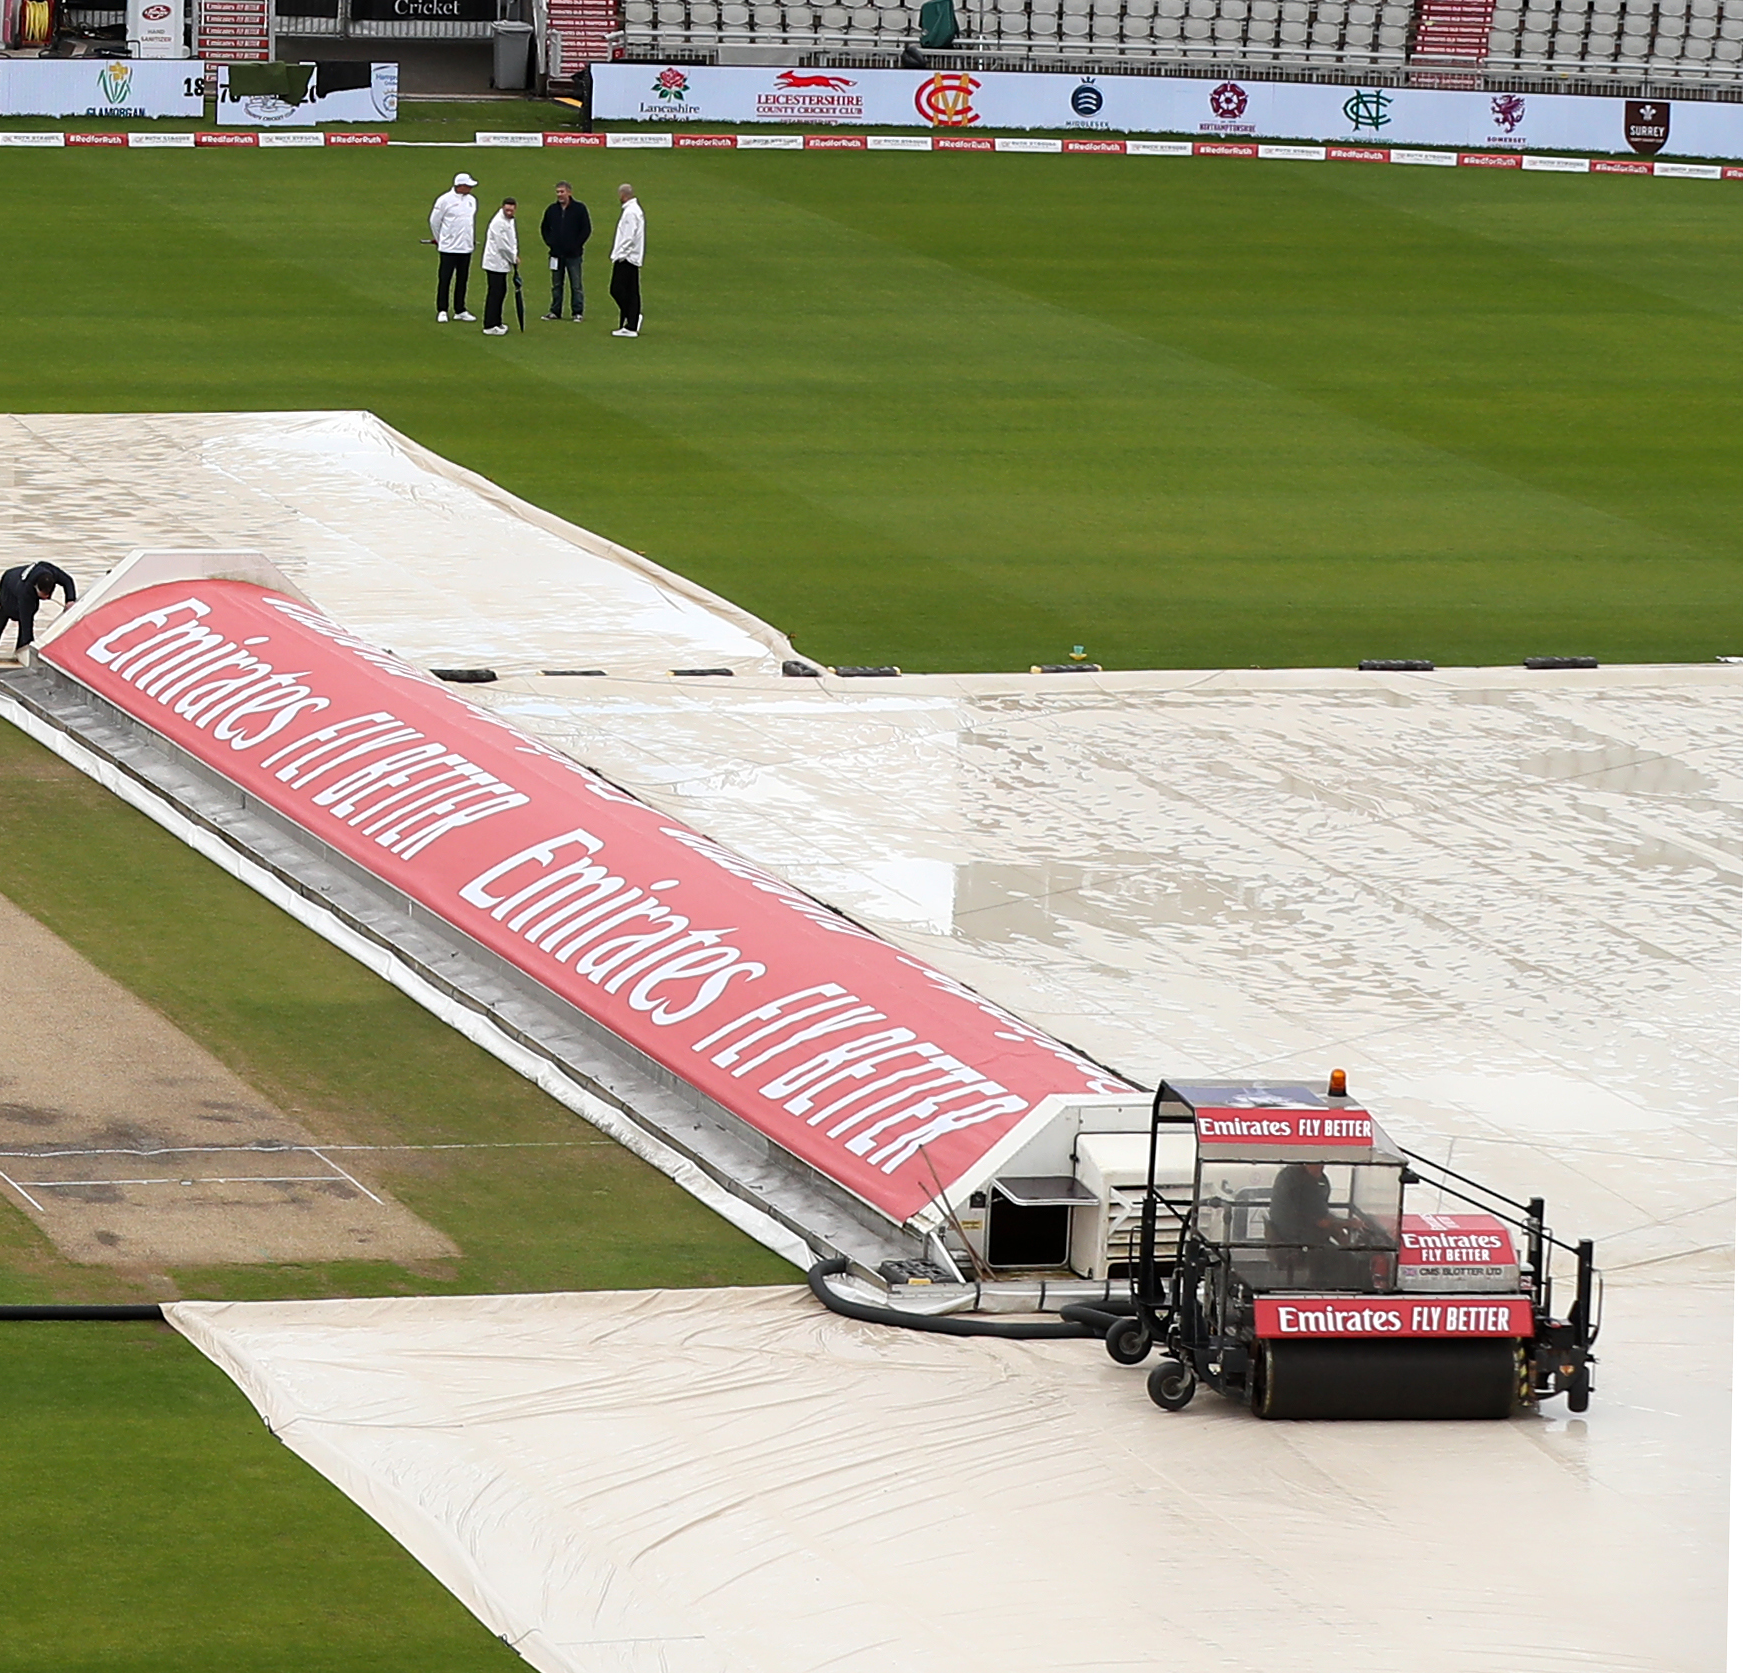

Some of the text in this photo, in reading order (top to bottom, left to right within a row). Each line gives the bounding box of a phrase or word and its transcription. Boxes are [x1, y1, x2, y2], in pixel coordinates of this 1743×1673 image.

[395, 0, 458, 14] Cricket
[757, 94, 864, 106] LEICESTERSHIRE
[639, 103, 700, 114] Lancashire
[757, 106, 863, 115] COUNTY CRICKET CLUB
[1629, 126, 1665, 138] SURREY
[200, 135, 254, 145] #RedforRuth
[546, 135, 600, 145] #RedforRuth
[1486, 136, 1527, 144] SOMERSET
[1069, 142, 1121, 152] #RedforRuth
[86, 597, 330, 750] Emirates
[262, 712, 405, 789] FLY
[314, 740, 530, 861] BETTER
[458, 828, 766, 1025] Emirates
[691, 981, 887, 1078] FLY
[757, 1026, 1030, 1173] BETTER
[1199, 1118, 1371, 1137] Emirates FLY BETTER
[1400, 1233, 1502, 1248] Emirates
[1422, 1249, 1490, 1261] FLY BETTER
[1419, 1267, 1503, 1276] CMS BLOTTER LTD
[1278, 1306, 1509, 1331] Emirates FLY BETTER
